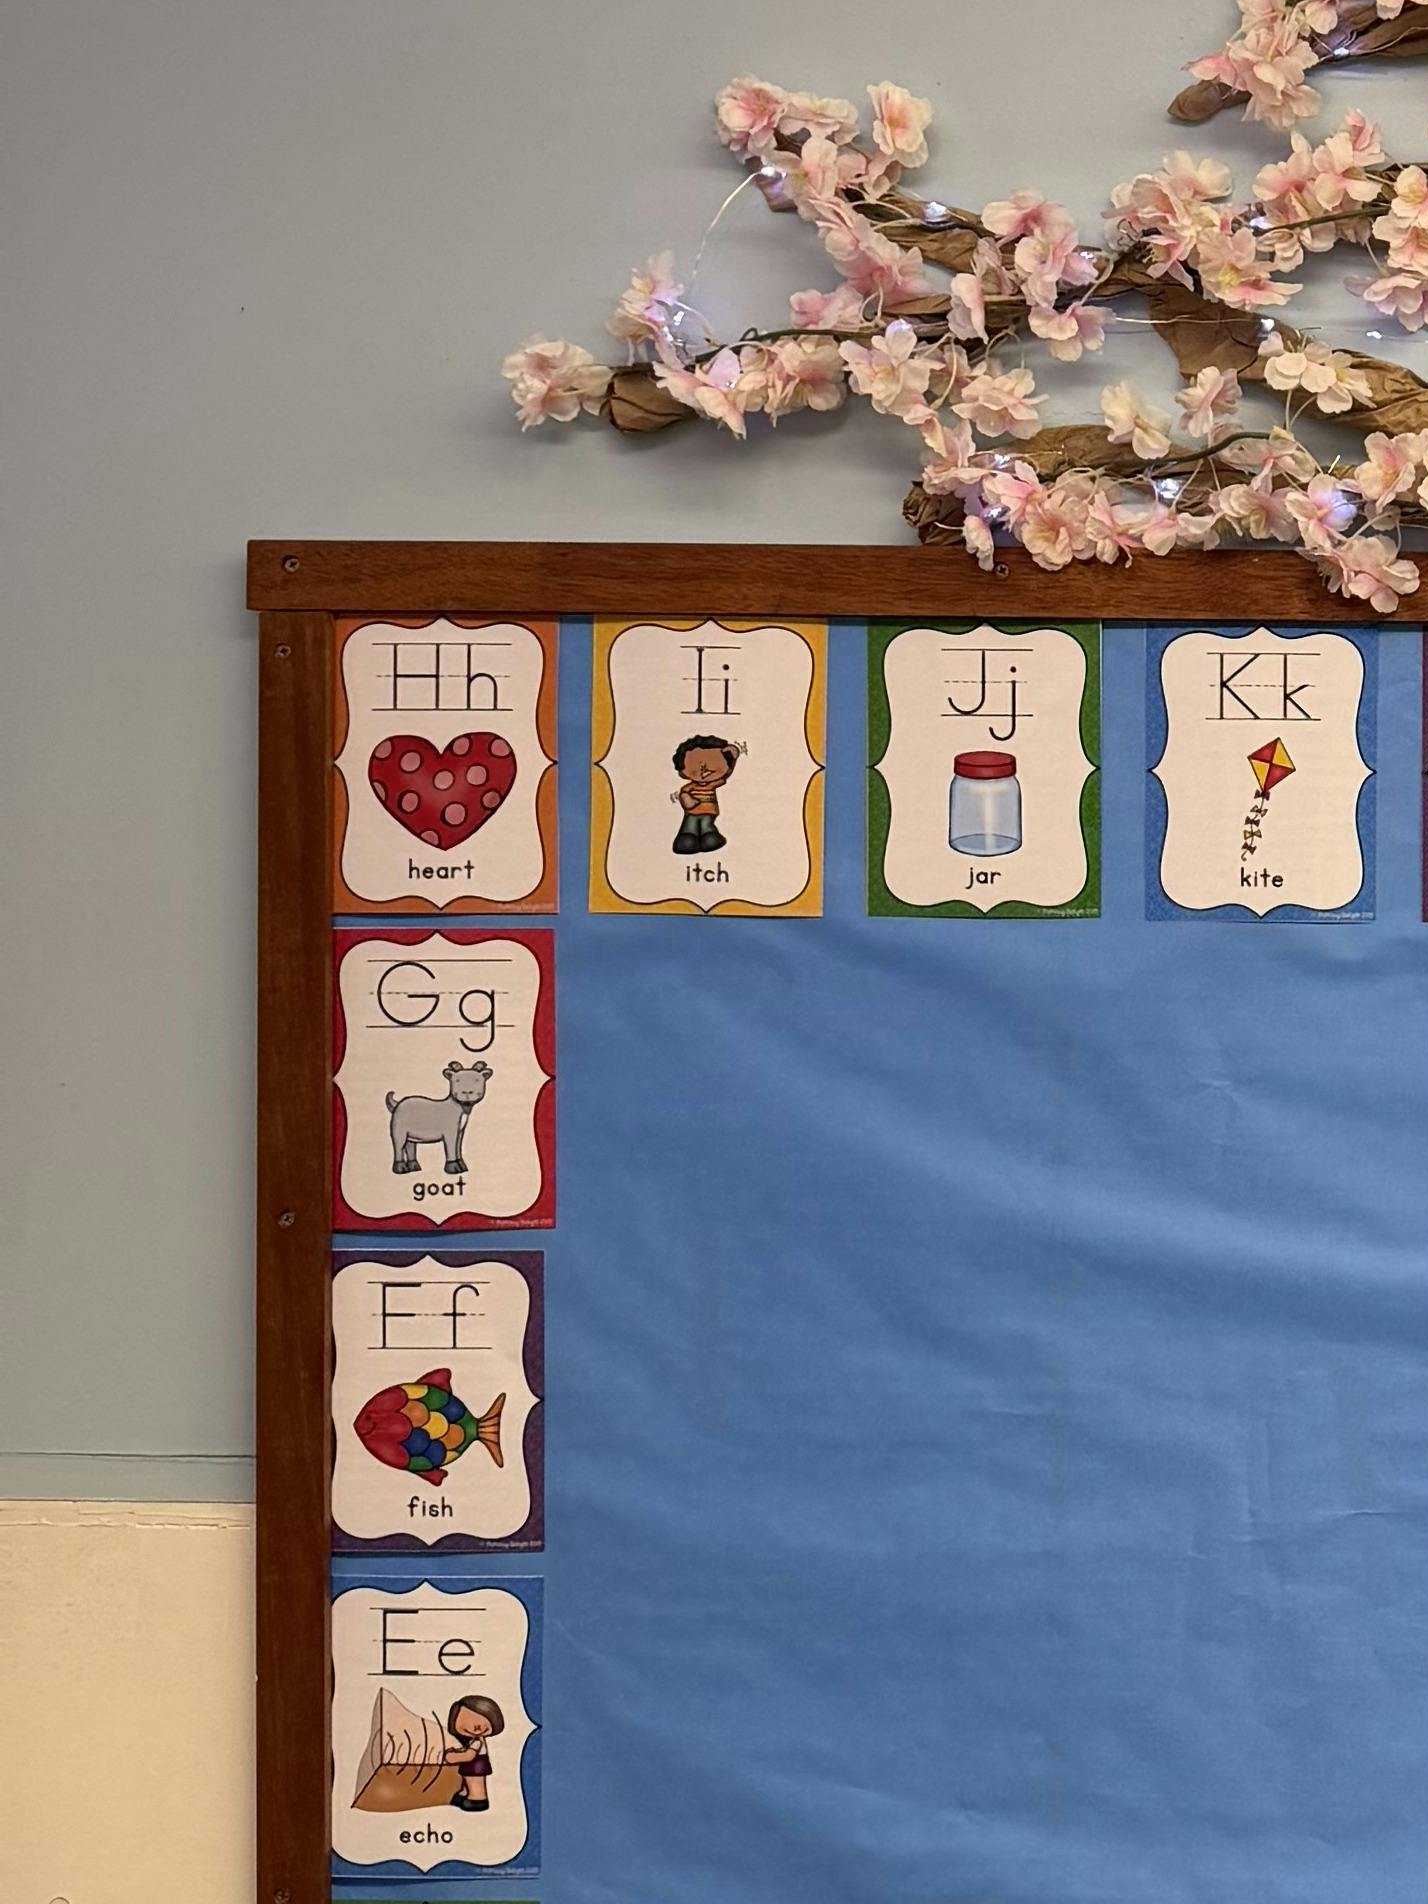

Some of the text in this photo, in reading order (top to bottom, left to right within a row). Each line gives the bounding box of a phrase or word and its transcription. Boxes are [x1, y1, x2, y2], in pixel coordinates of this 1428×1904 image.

[390, 643, 501, 711] Hh
[1218, 653, 1312, 720] Kk
[947, 649, 1018, 741] Jj
[407, 857, 476, 881] heart
[685, 860, 731, 884] itch
[964, 865, 1003, 891] jar
[1239, 865, 1285, 889] kite
[377, 961, 496, 1051] Gg
[411, 1174, 467, 1203] goat
[381, 1283, 479, 1349] Ff
[406, 1494, 454, 1519] fish
[383, 1609, 476, 1675] Ee
[398, 1821, 454, 1845] echo
